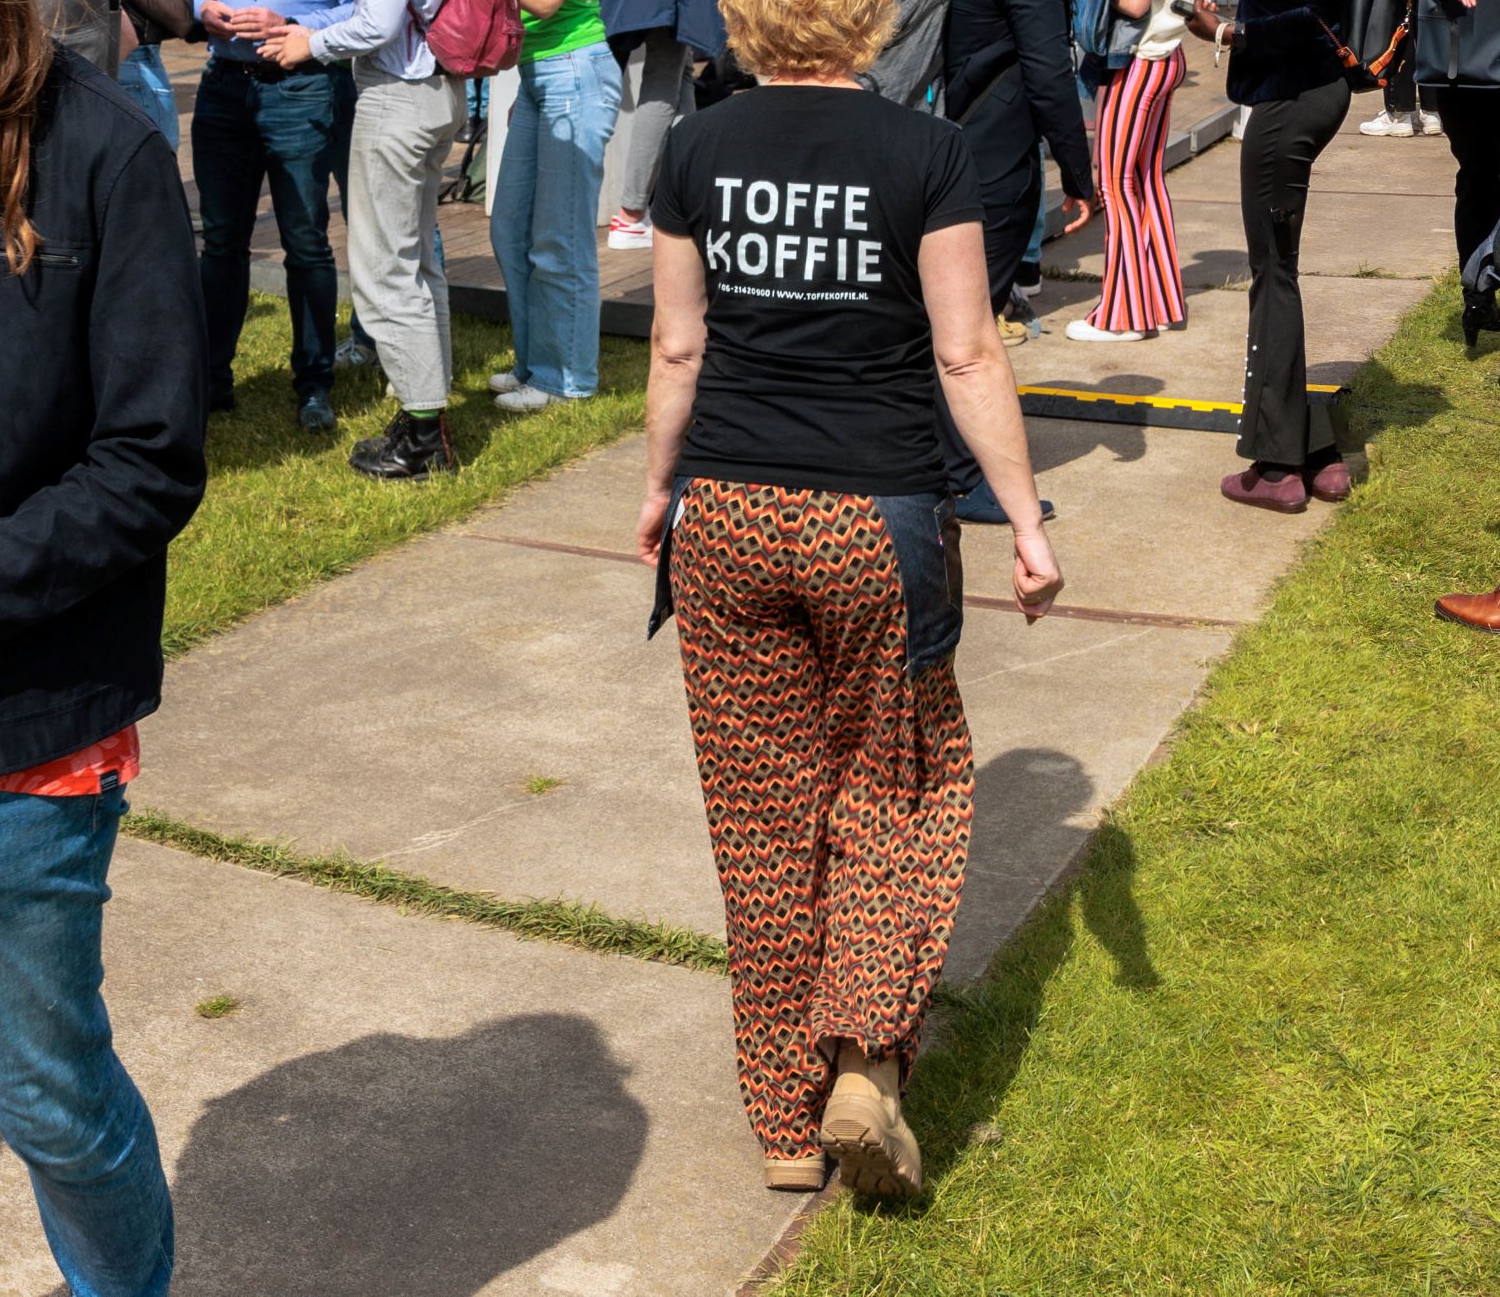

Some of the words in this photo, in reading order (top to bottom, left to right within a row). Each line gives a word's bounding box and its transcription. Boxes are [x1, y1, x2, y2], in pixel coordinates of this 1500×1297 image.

[714, 177, 871, 232] TOFFE
[705, 228, 883, 283] KOFFIE
[776, 289, 870, 301] WWW.TOFFEKOFFIE.NL
